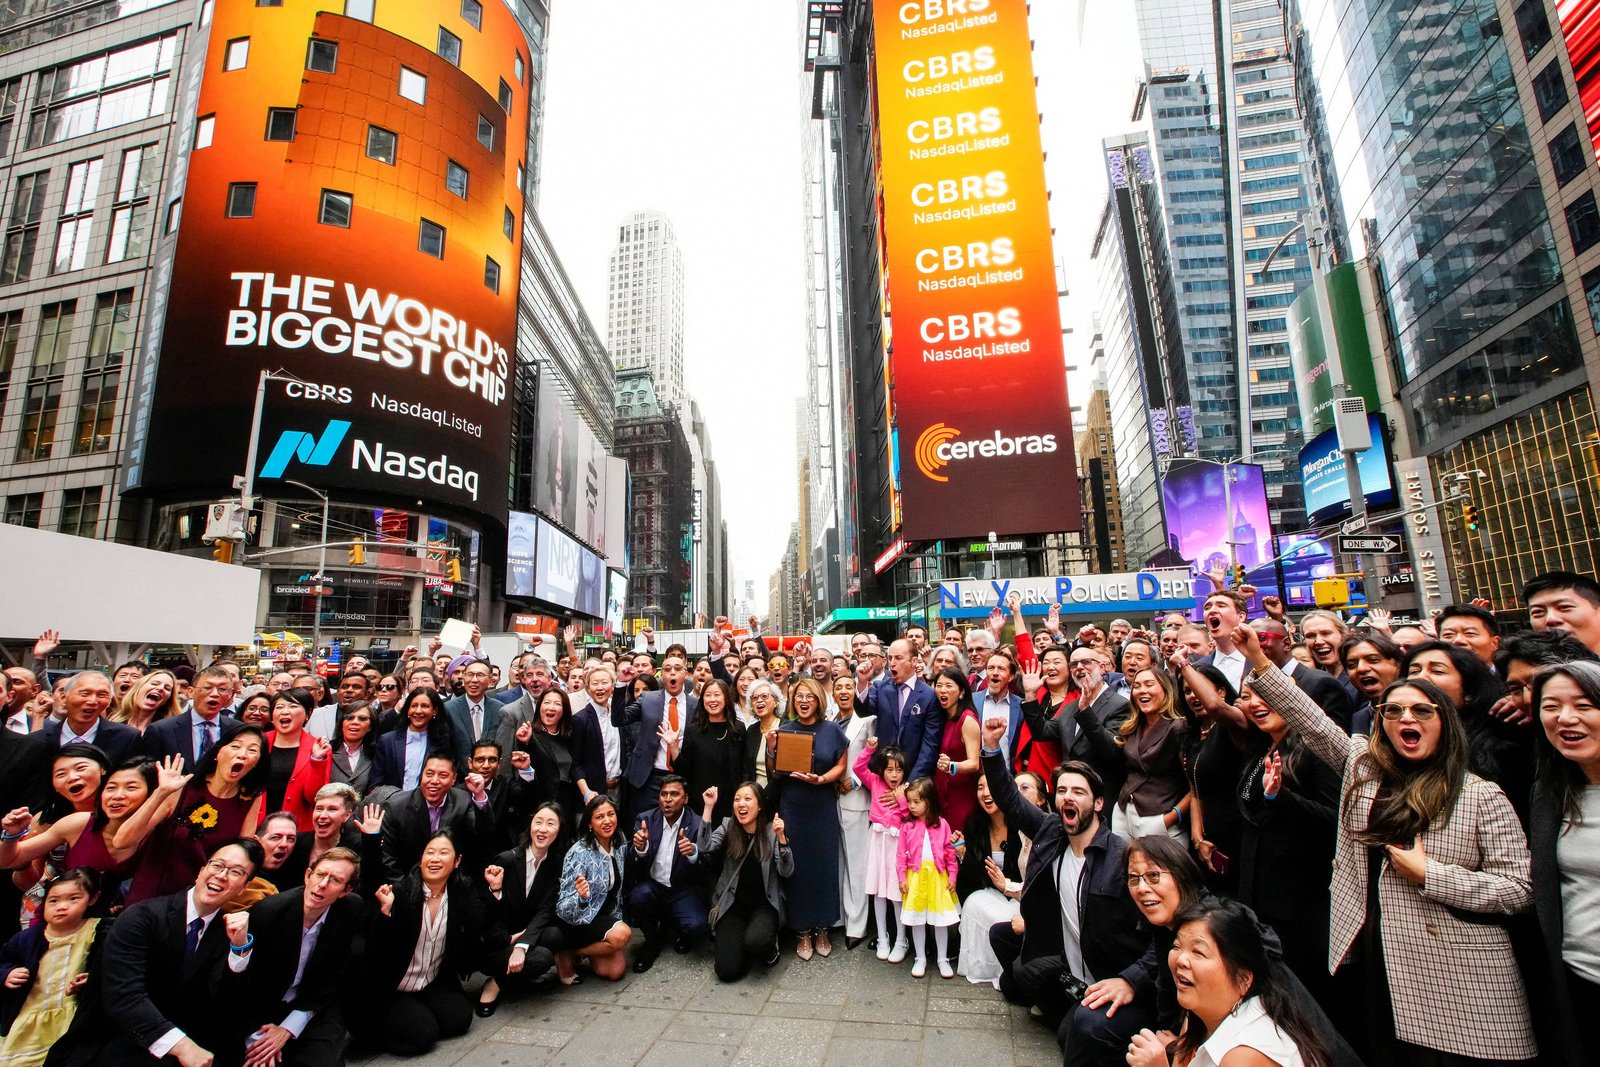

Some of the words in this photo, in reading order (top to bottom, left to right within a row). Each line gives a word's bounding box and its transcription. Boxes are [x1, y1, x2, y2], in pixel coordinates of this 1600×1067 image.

[902, 11, 998, 40] NasdaqListed
[902, 45, 997, 83] CBRS
[905, 71, 1004, 99] NasdaqListed
[906, 106, 1003, 144] CBRS
[909, 134, 1010, 161] NasdaqListed
[911, 170, 1009, 207] CBRS
[913, 199, 1017, 225] NasdaqListed
[915, 236, 1016, 274] CBRS
[918, 267, 1023, 292] NasdaqListed
[230, 271, 335, 314] THE
[344, 282, 509, 380] WORLD'S
[919, 306, 1023, 344] CBRS
[225, 308, 442, 375] BIGGEST
[443, 350, 506, 407] CHIP
[922, 339, 1031, 362] NasdaqListed
[286, 381, 353, 404] CBRS
[371, 392, 483, 439] NasdaqListed
[937, 429, 1058, 461] cerebras
[351, 438, 480, 502] Nasdaq
[1406, 471, 1430, 536] SQUARE
[969, 541, 1023, 553] NEWTDITION
[1347, 540, 1366, 548] ONE
[1372, 540, 1392, 548] WAY
[276, 586, 310, 594] branded
[309, 574, 334, 583] Ndaq
[939, 581, 989, 609] NEW
[990, 580, 1050, 608] YORK
[1055, 577, 1130, 604] POLICE
[1136, 572, 1197, 600] DEPT
[1420, 549, 1442, 600] TIMES
[334, 612, 366, 622] Nasdaq
